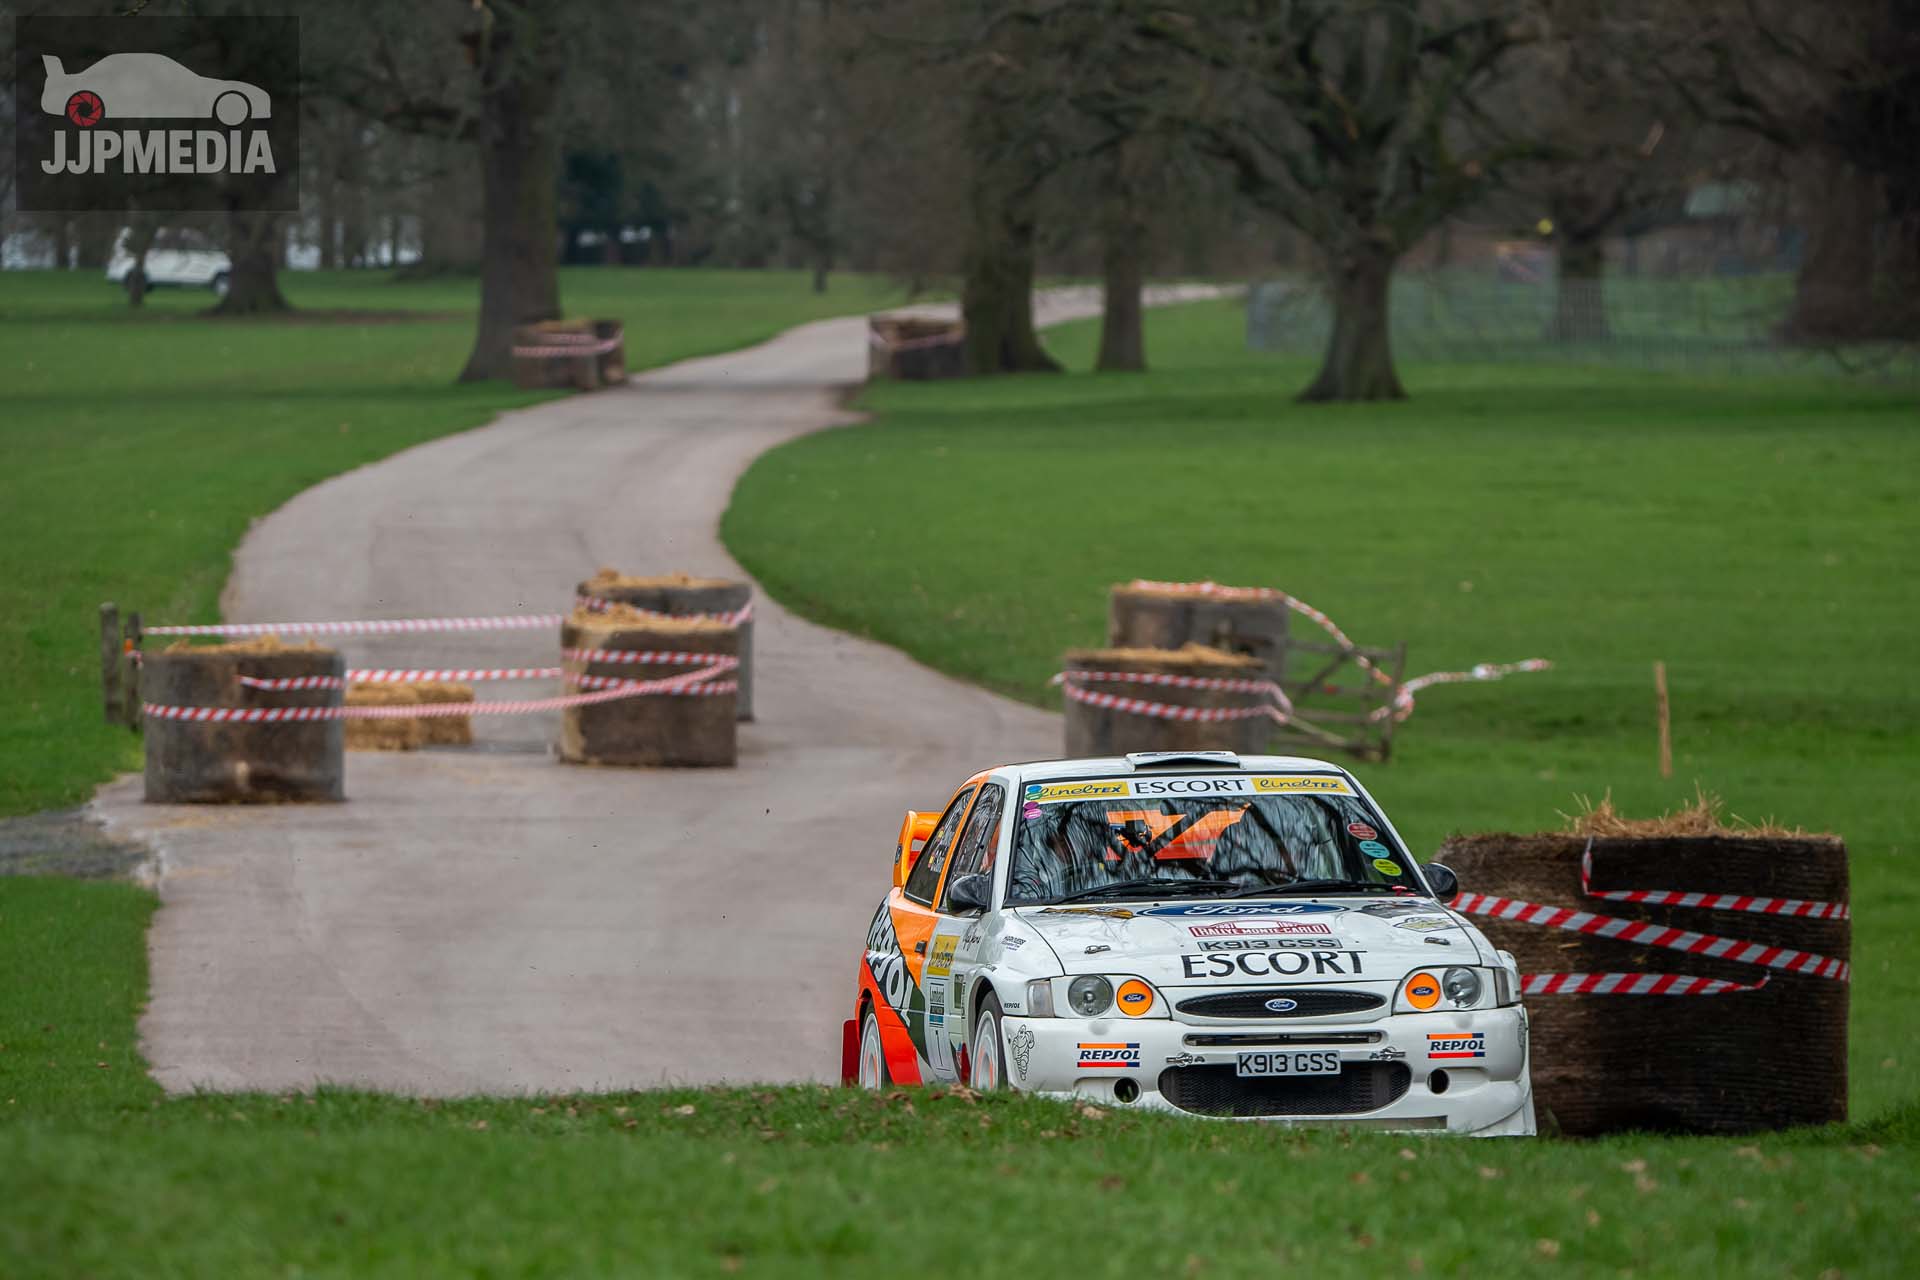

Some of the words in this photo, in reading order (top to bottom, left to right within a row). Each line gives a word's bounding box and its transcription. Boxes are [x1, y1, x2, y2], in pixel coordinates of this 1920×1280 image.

[1135, 779, 1246, 794] ESCORT
[1184, 904, 1304, 916] Ford
[1199, 927, 1241, 936] RALLYE
[1204, 939, 1270, 950] K913
[1278, 938, 1337, 949] GSS
[1181, 950, 1367, 979] ESCORT
[1271, 1000, 1290, 1009] Ford
[1430, 1040, 1486, 1051] REPSOL
[1079, 1049, 1140, 1060] REPSOL
[1238, 1053, 1289, 1074] K913
[1295, 1052, 1338, 1072] GSS
